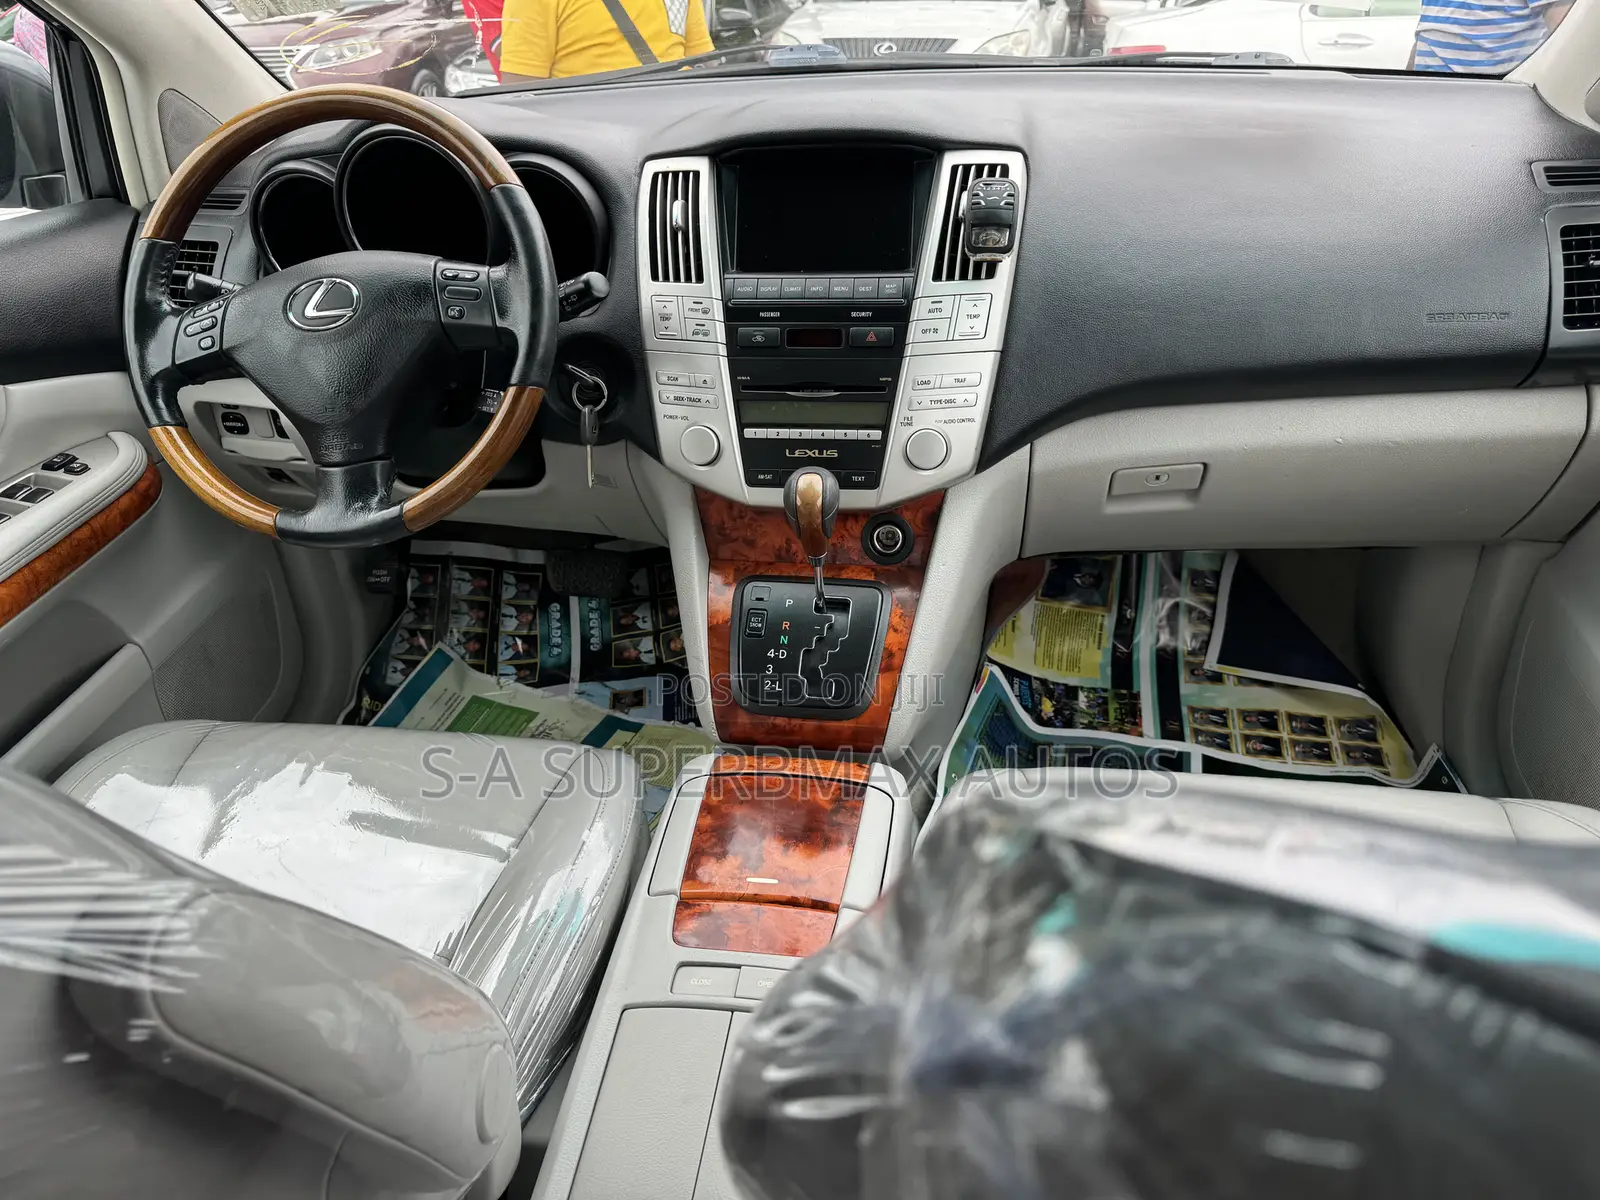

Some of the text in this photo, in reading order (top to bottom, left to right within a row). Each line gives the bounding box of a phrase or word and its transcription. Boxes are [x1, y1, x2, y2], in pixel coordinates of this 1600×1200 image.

[785, 449, 839, 458] LEXUS
[785, 599, 794, 608] P
[548, 602, 562, 646] GRADE
[781, 621, 790, 631] R
[588, 609, 602, 651] GRADE
[779, 635, 788, 645] N
[766, 648, 787, 659] 4-D
[765, 664, 773, 675] 3
[763, 680, 782, 691] 2-L
[690, 977, 713, 986] CLOSE
